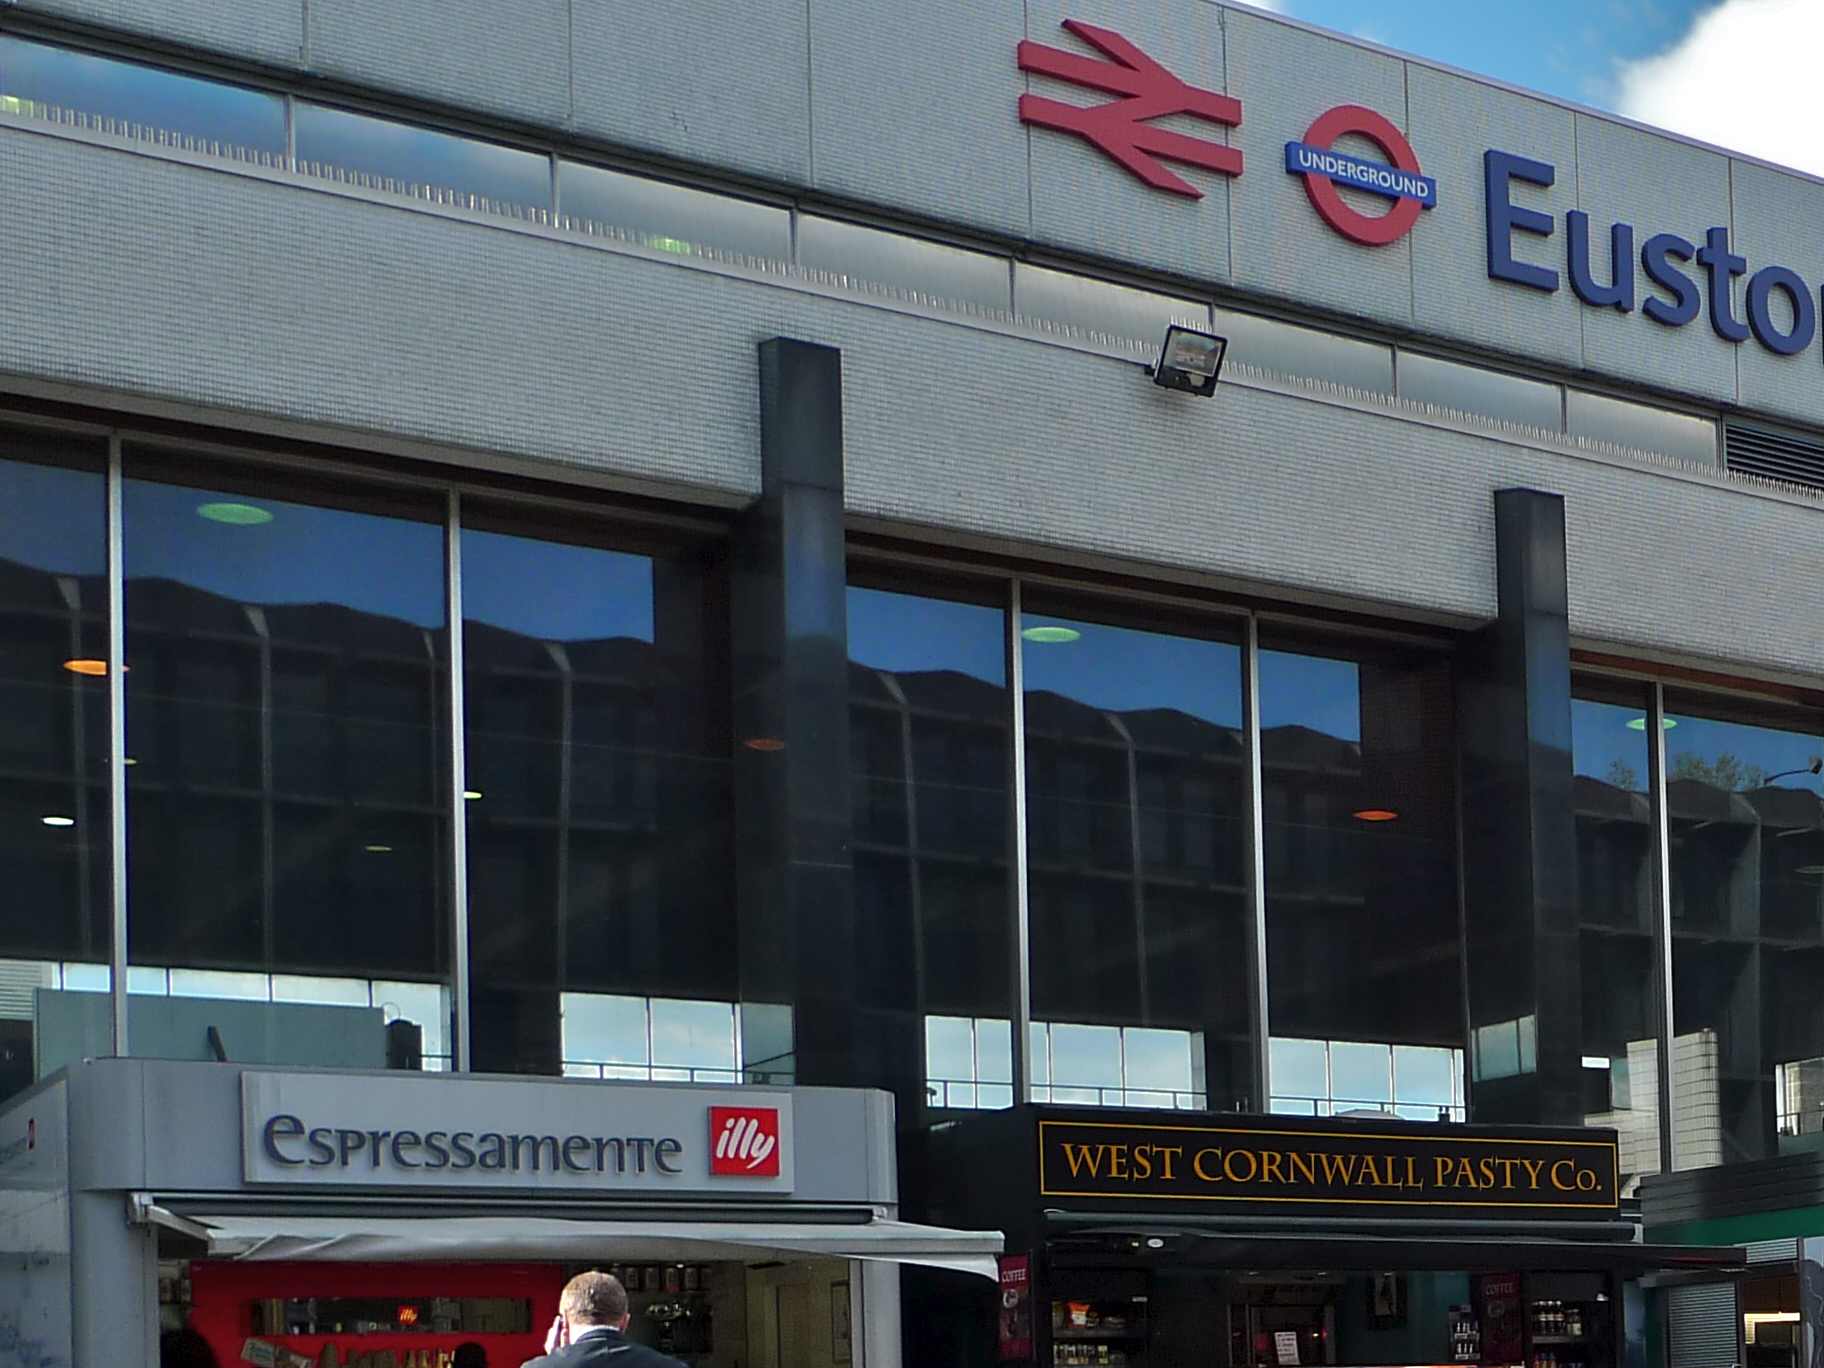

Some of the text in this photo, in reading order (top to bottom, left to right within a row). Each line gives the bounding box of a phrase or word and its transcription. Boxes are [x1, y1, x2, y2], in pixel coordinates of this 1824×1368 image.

[1299, 149, 1429, 198] UNDERGROUND
[263, 1113, 684, 1174] espressamente
[715, 1117, 776, 1169] illy
[1061, 1142, 1182, 1181] WEST
[1194, 1147, 1425, 1190] CORNWALL
[1434, 1155, 1546, 1192] PASTY
[1002, 1268, 1027, 1282] COFFEE
[1485, 1282, 1514, 1296] COFFEE
[399, 1307, 418, 1322] illy
